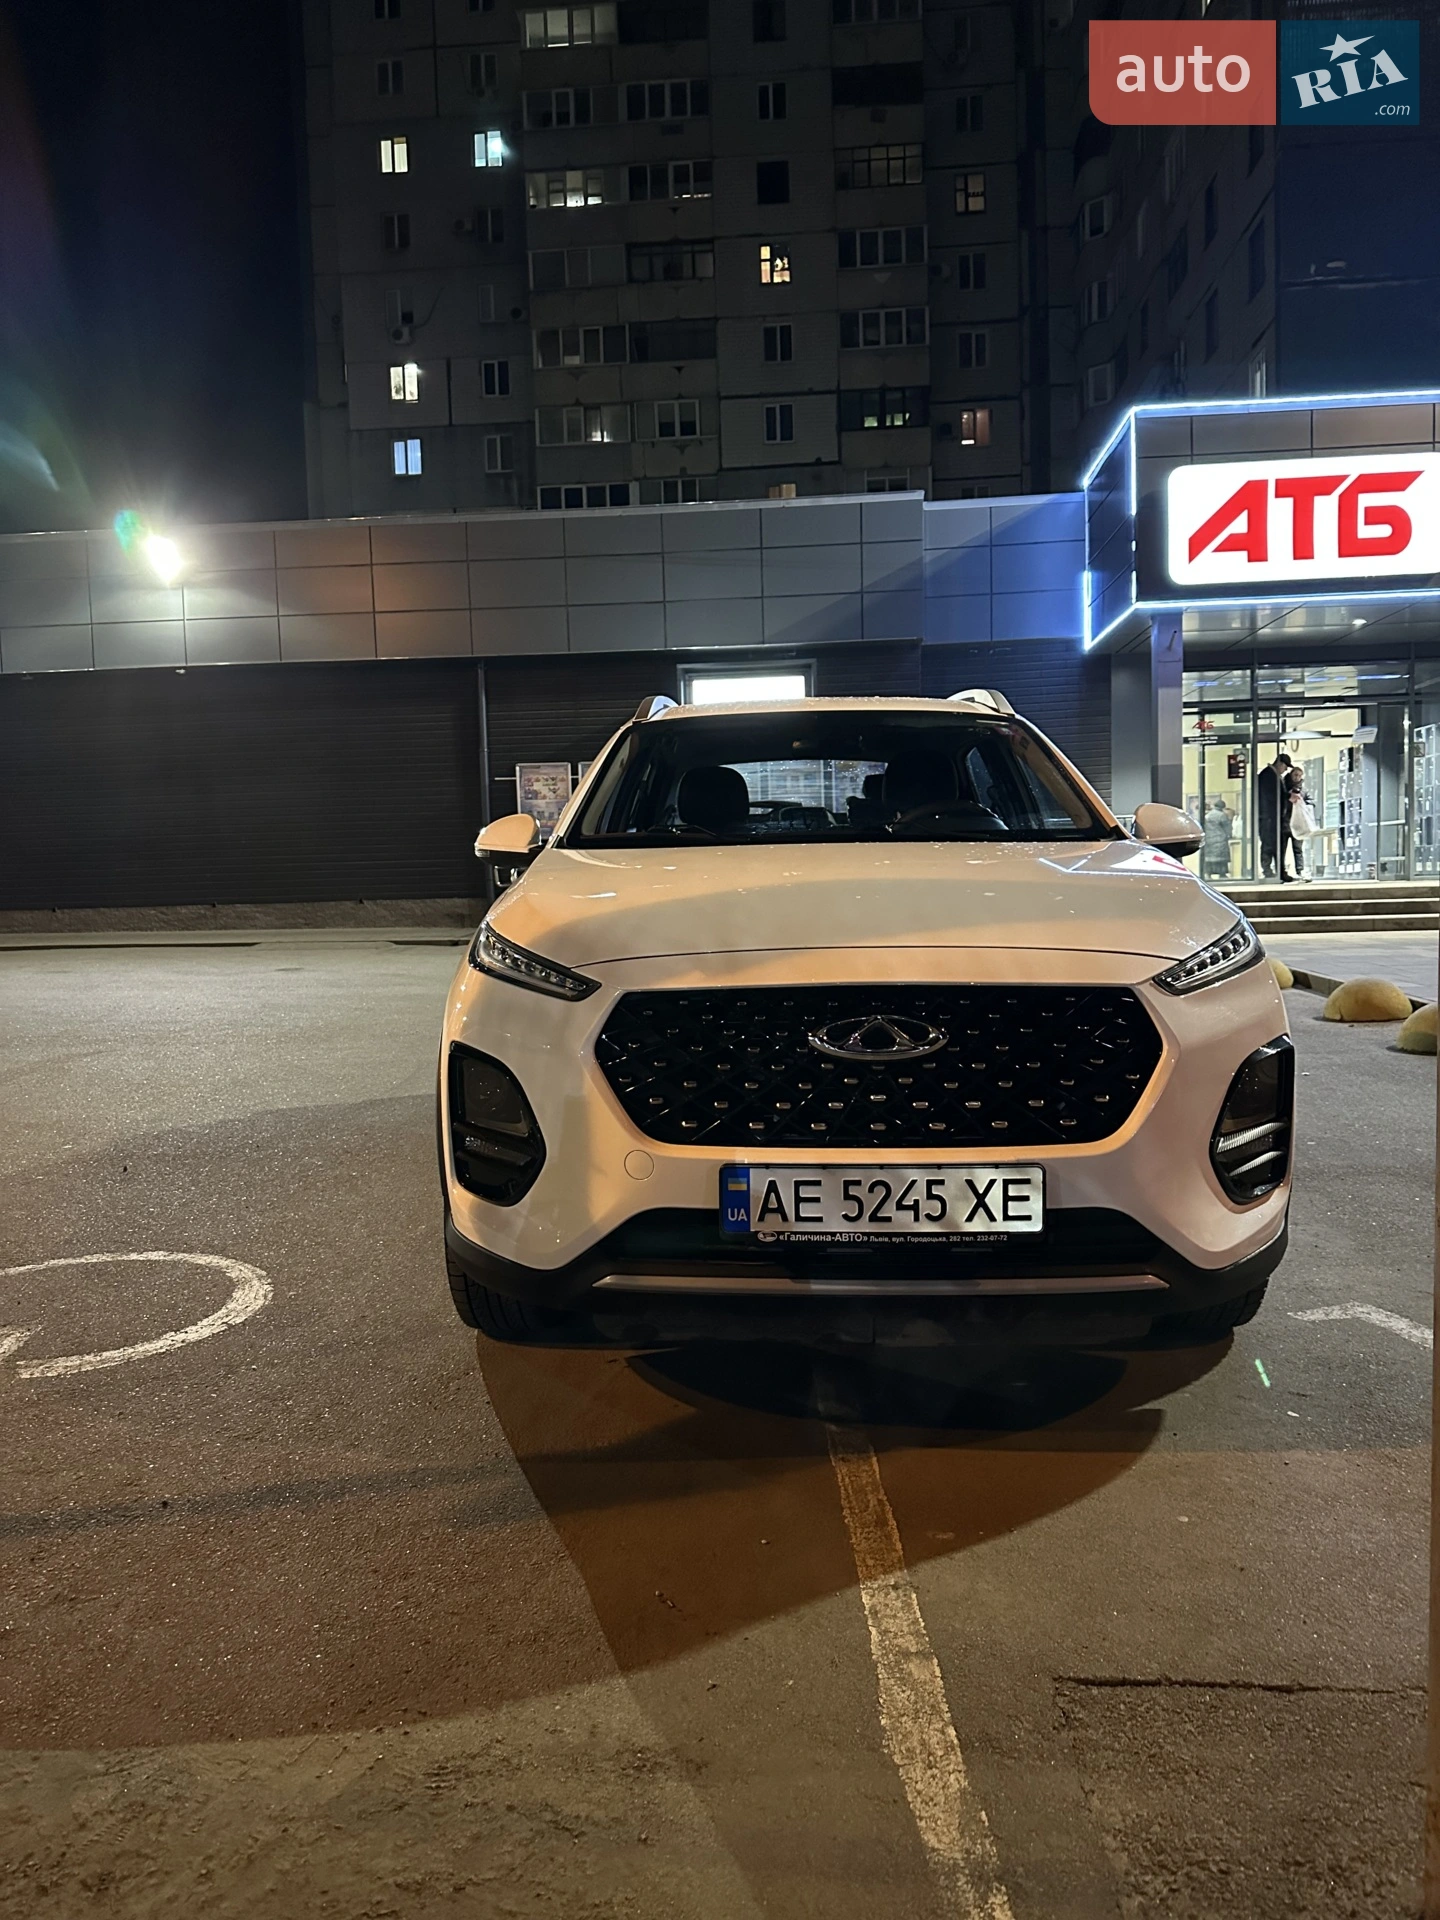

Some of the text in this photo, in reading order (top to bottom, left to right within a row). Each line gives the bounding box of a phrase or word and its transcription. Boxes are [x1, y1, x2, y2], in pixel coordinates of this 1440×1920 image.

[1188, 470, 1425, 565] АТБ
[757, 1178, 1033, 1222] AE 5245 XE
[728, 1208, 748, 1222] UA
[779, 1232, 868, 1242] «Галичина-АВТО»
[977, 1234, 1008, 1242] 232-07-72
